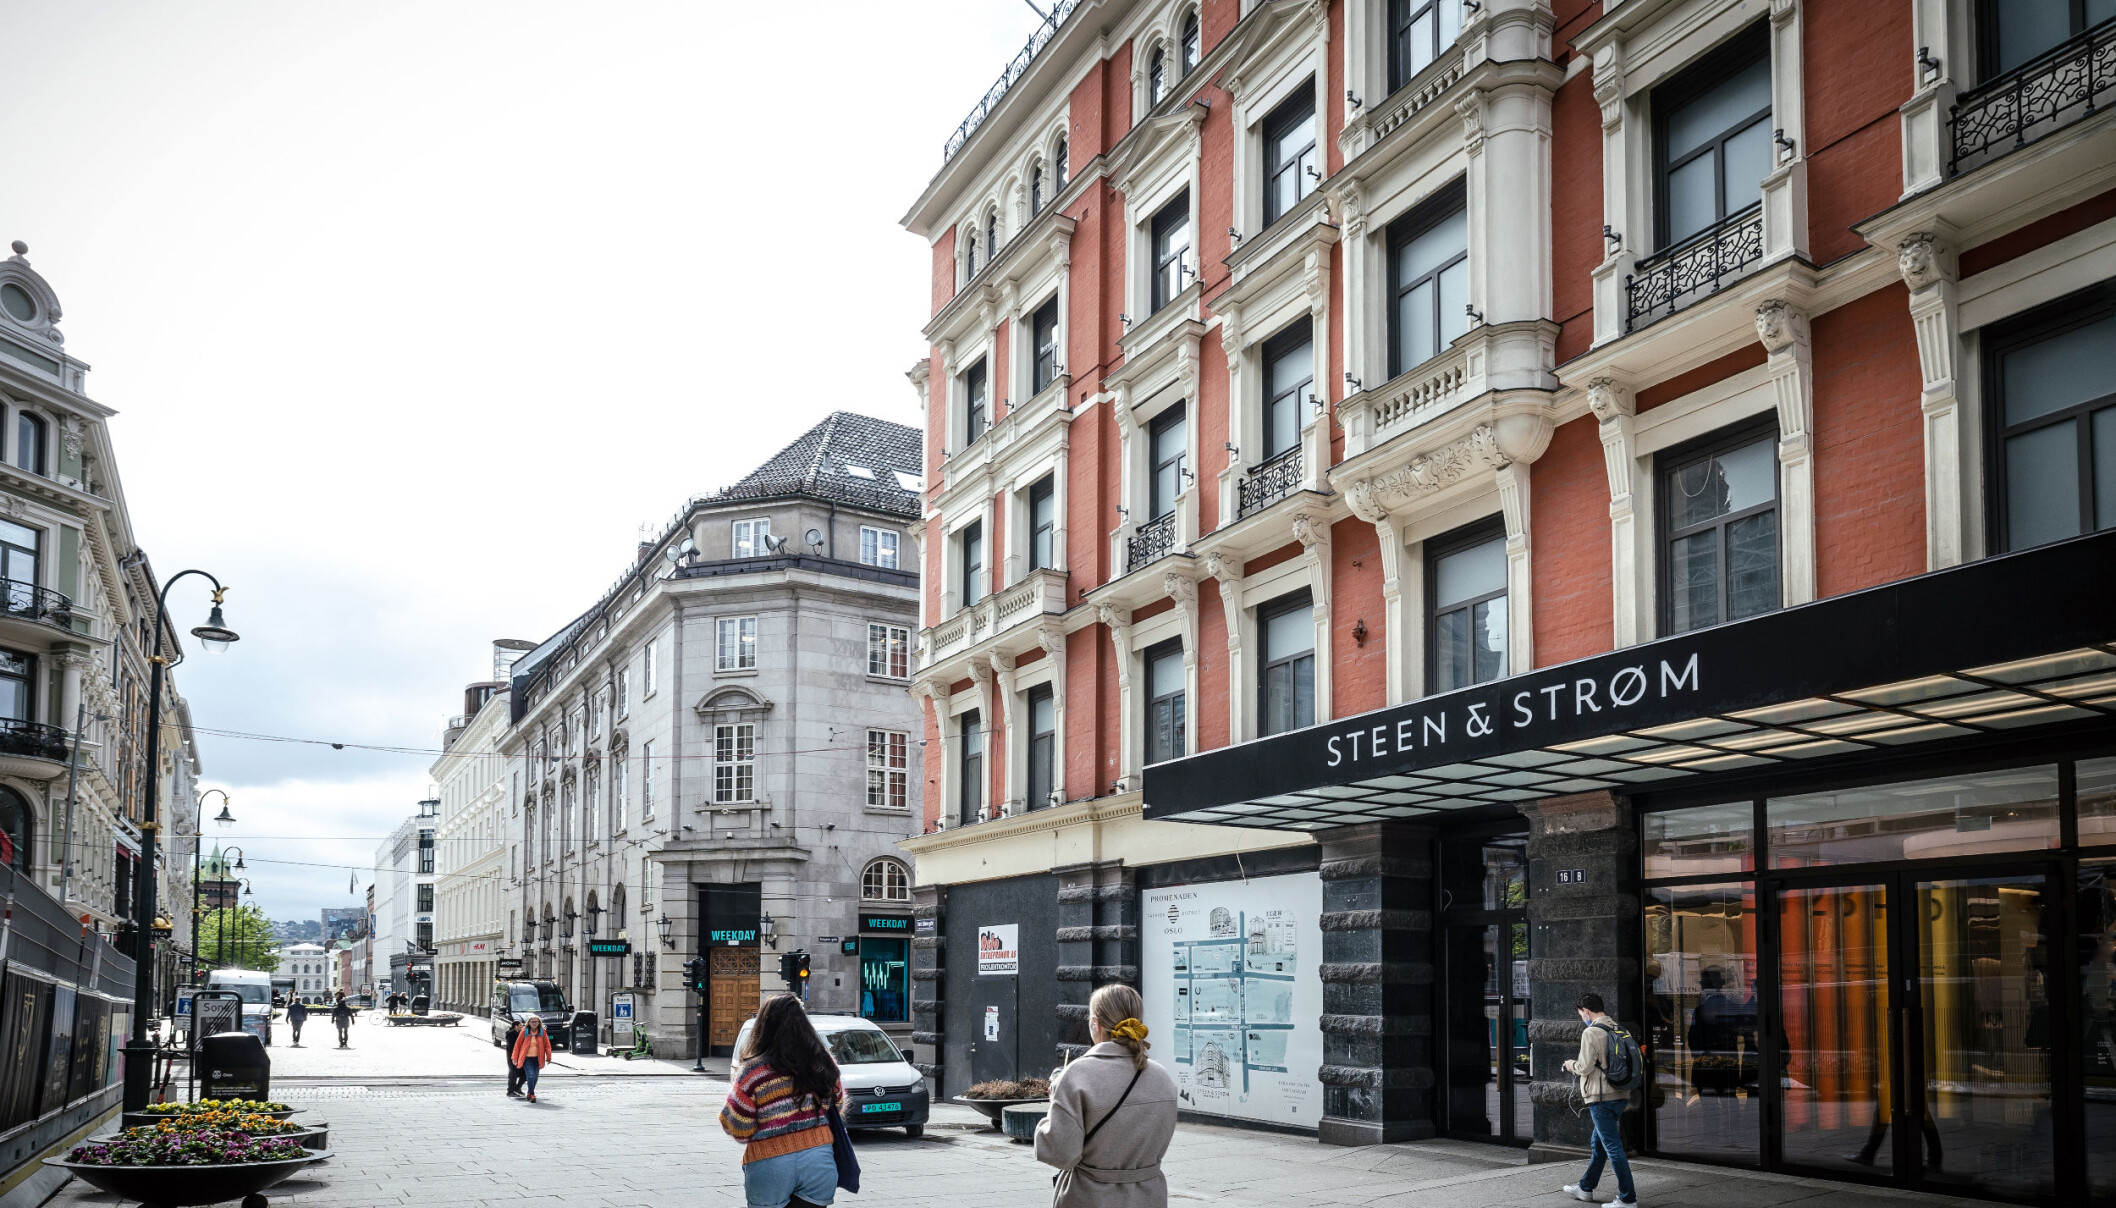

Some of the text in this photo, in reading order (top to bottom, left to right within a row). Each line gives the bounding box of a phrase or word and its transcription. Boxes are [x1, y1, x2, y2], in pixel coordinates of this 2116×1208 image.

[1327, 653, 1699, 767] STEEN & STRØM
[1559, 872, 1569, 882] 16
[1150, 892, 1198, 903] PROMENADEN
[868, 918, 907, 929] WEEKDAY
[711, 930, 756, 941] WEEKDAY
[1164, 927, 1183, 935] OSLO
[591, 944, 625, 952] WEEKDAY
